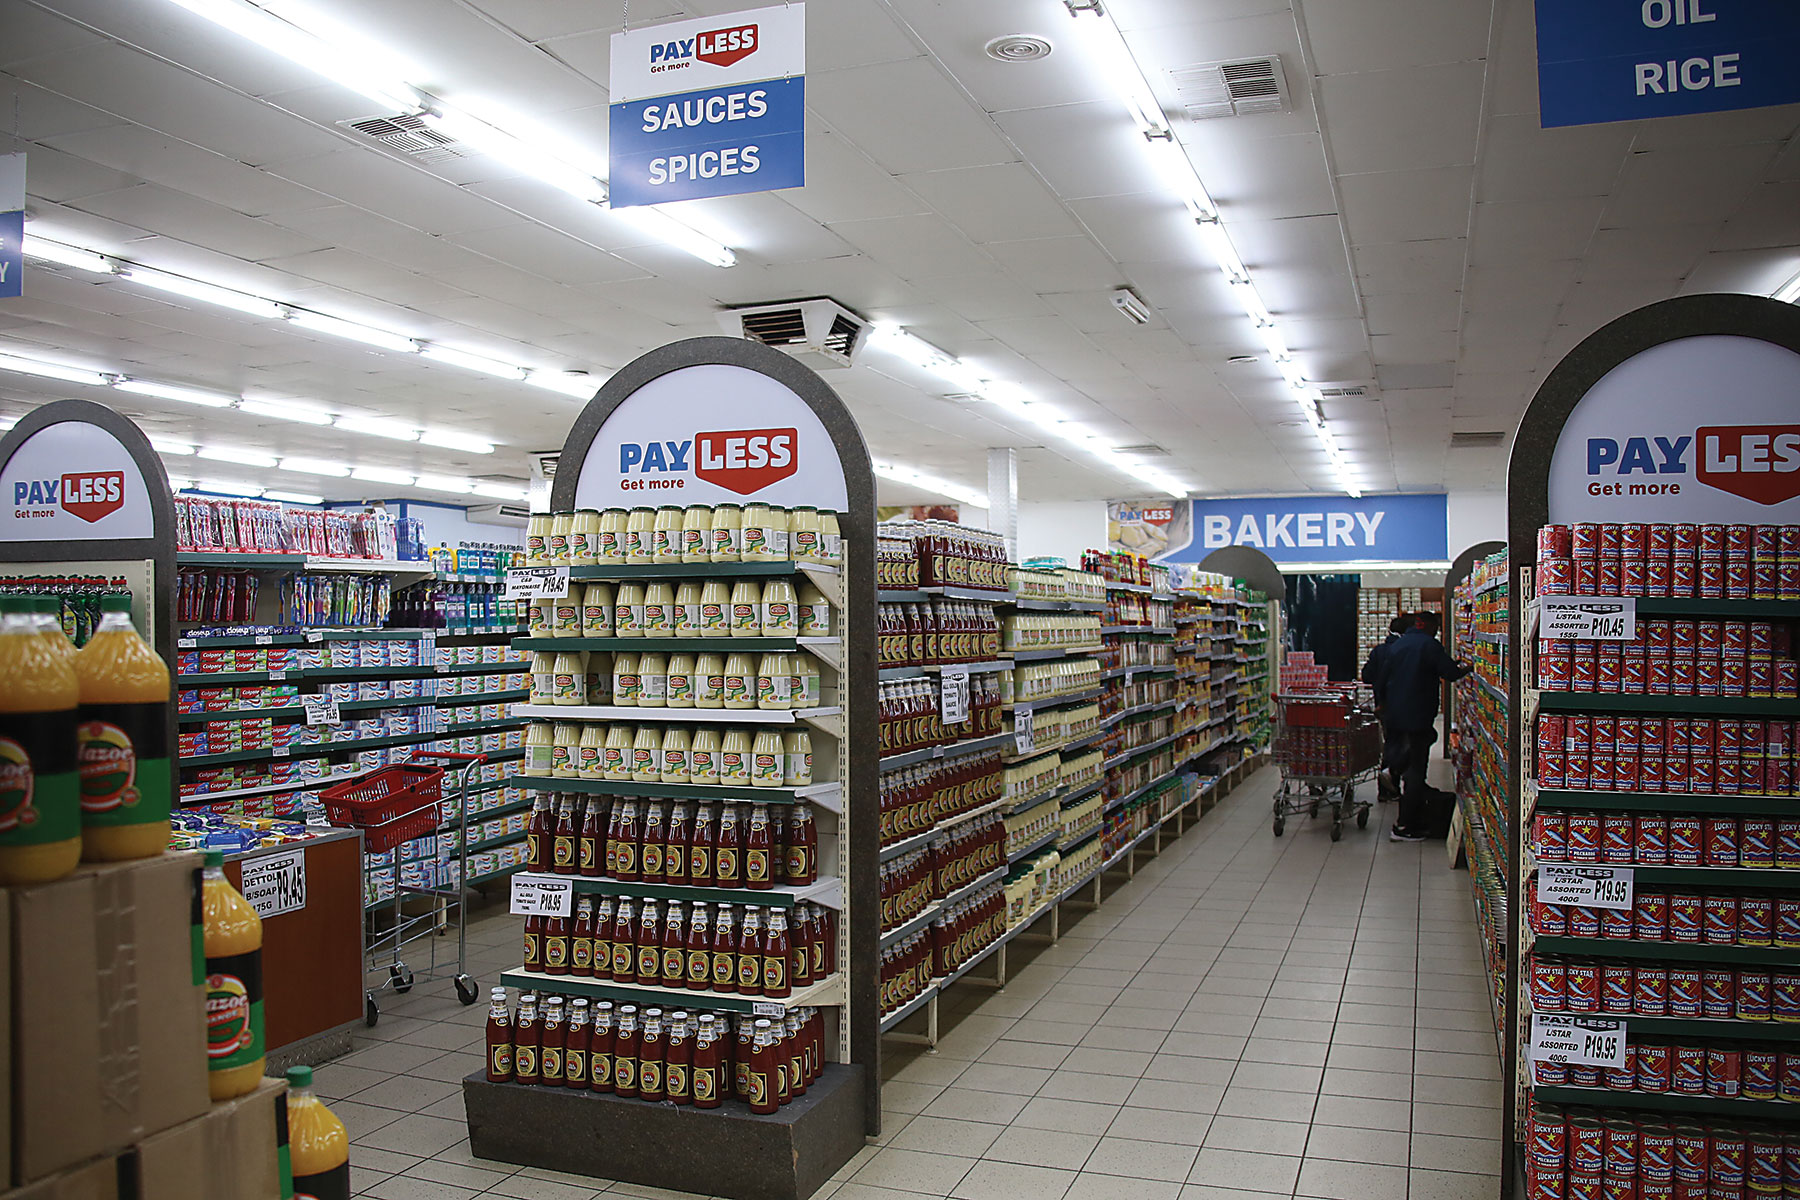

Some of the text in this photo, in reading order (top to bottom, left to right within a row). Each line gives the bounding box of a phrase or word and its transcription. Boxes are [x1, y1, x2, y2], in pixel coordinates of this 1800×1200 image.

[1641, 0, 1716, 28] OIL
[651, 29, 754, 63] PAY LESS
[651, 62, 690, 73] Get more
[1635, 53, 1741, 96] RICE
[642, 90, 767, 132] SAUCES
[649, 146, 760, 185] SPICES
[620, 435, 791, 473] PAY LESS
[1587, 434, 1800, 475] PAY LES
[14, 477, 120, 505] PAY LESS
[621, 479, 684, 490] Get more
[1588, 482, 1681, 496] Get more
[15, 510, 30, 518] Get
[1120, 511, 1171, 520] PAY LESS
[1204, 512, 1385, 548] BAKERY
[542, 576, 565, 592] P19.45
[1591, 618, 1624, 636] P10.45
[79, 744, 132, 761] azoe
[1570, 819, 1586, 827] LUCKY
[243, 866, 264, 875] PAY
[268, 860, 292, 869] LESS
[244, 873, 276, 887] DETTOL
[246, 887, 277, 901] B/SOAP
[277, 866, 302, 909] P9.45
[1546, 886, 1591, 894] ASSORTED
[1594, 880, 1627, 902] P19.95
[540, 894, 561, 911] P18.95
[1535, 967, 1551, 975] LUCKY
[206, 995, 248, 1010] azoe
[1540, 1016, 1572, 1024] PAY
[1576, 1018, 1617, 1028] LESS
[1546, 1029, 1572, 1038] L/STAR
[1539, 1041, 1579, 1051] ASSORTED
[1584, 1035, 1617, 1060] P19.95
[1548, 1054, 1567, 1062] 400G
[1652, 1050, 1665, 1058] STAR
[1711, 1053, 1725, 1063] STAR
[1535, 1124, 1551, 1133] LUCKY
[1580, 1131, 1597, 1139] LUCKY
[1645, 1137, 1662, 1145] LUCKY
[1716, 1142, 1735, 1150] LUCKY
[1538, 1172, 1555, 1180] LUCKY
[1571, 1175, 1587, 1183] LUCKY
[1645, 1185, 1662, 1193] LUCKY
